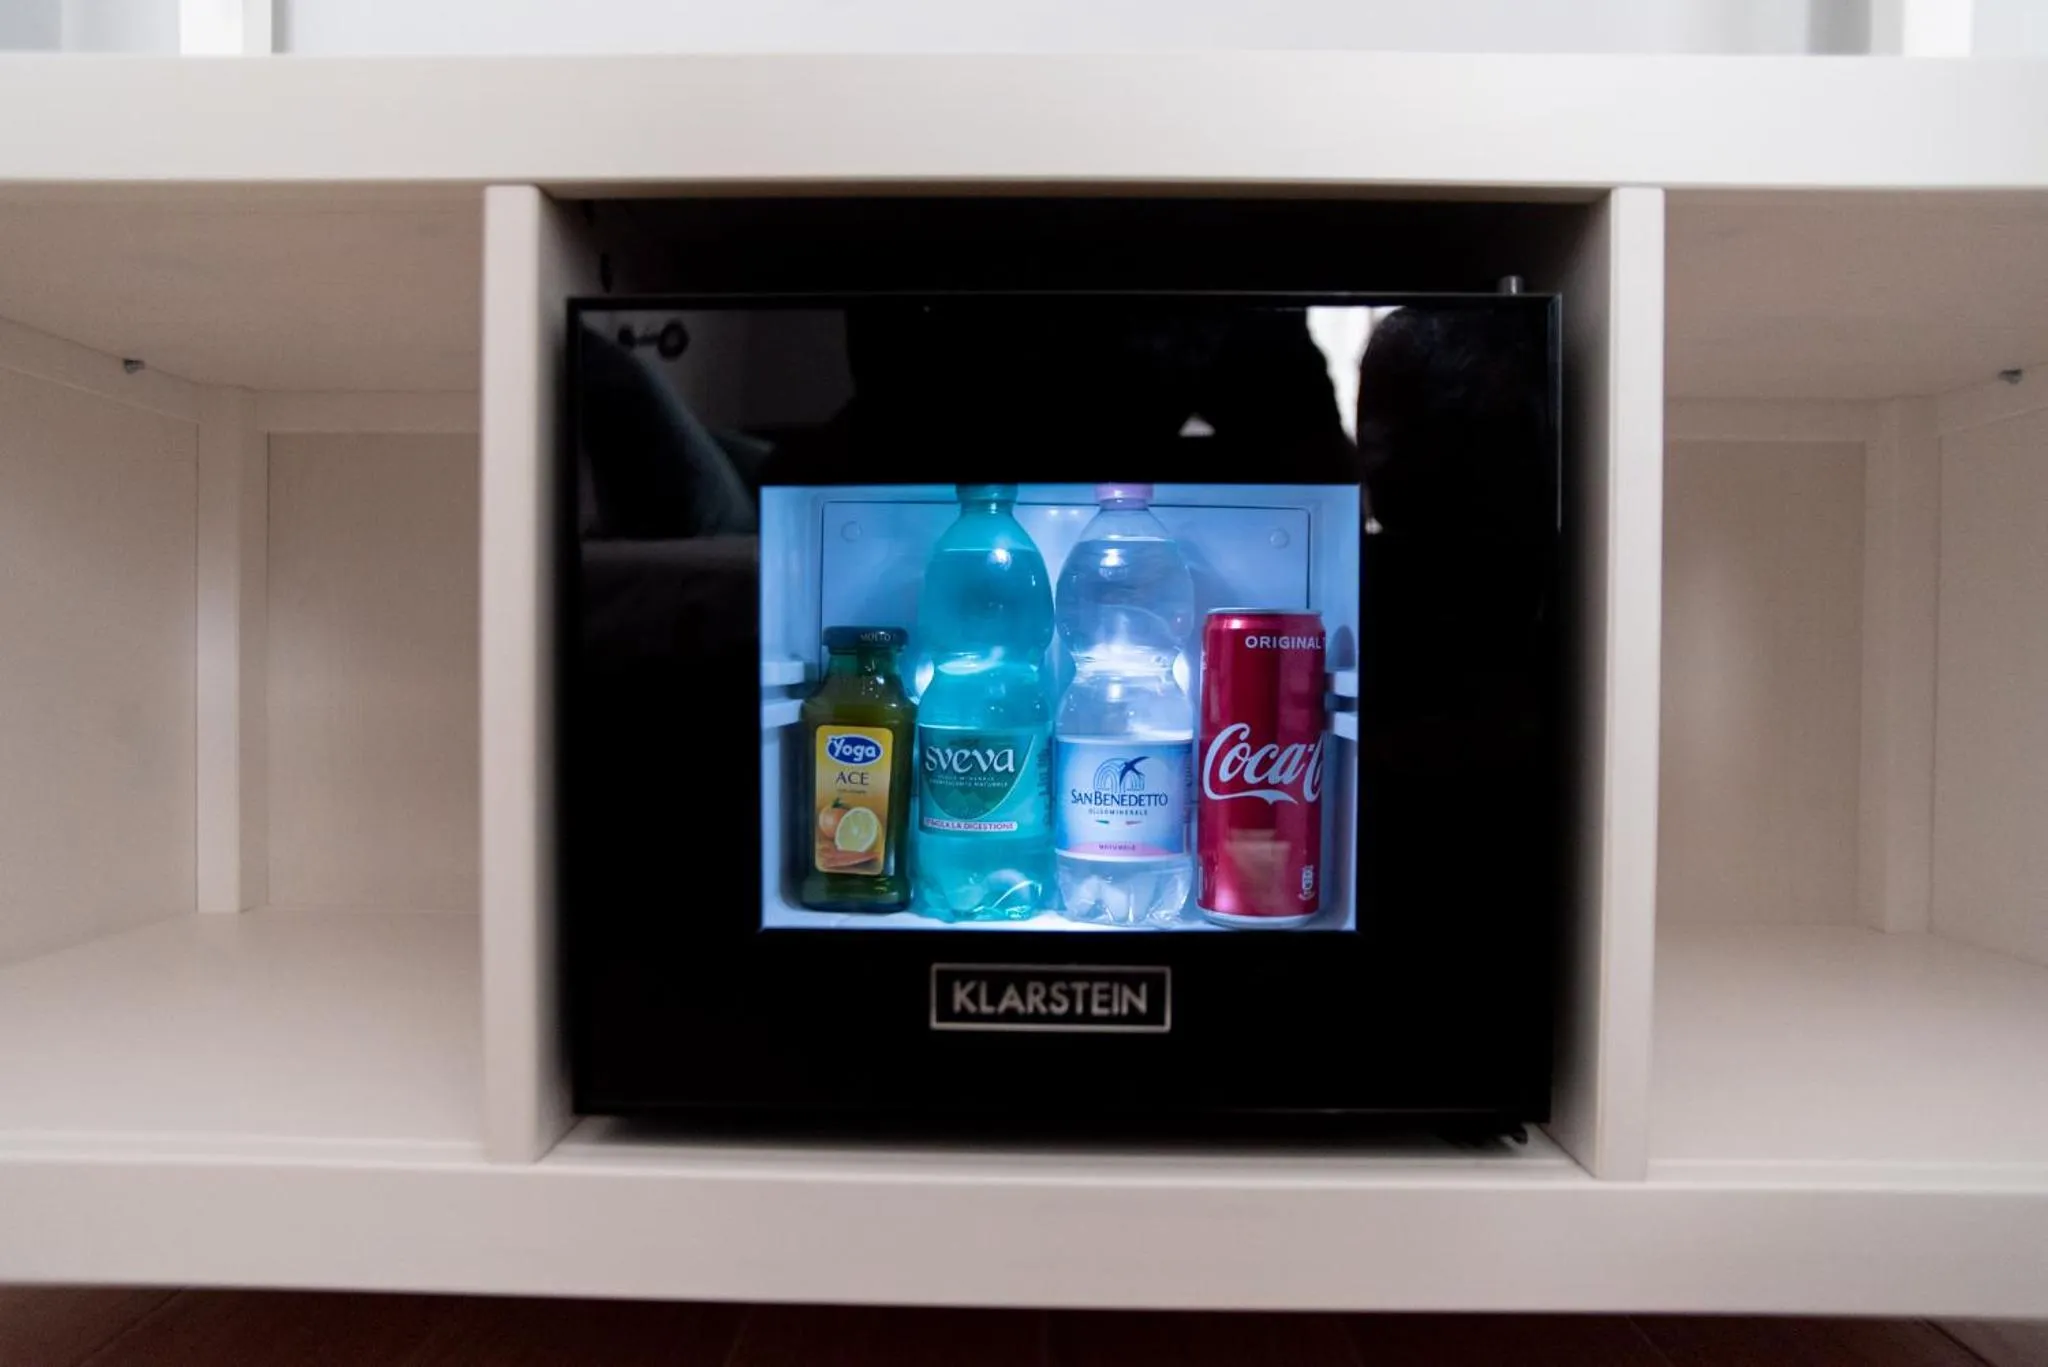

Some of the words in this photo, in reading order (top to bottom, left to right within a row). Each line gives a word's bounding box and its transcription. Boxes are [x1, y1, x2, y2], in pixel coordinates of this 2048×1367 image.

[1244, 635, 1321, 649] ORIGINAL
[831, 737, 877, 762] Yoga
[836, 771, 869, 786] ACE
[1071, 788, 1093, 805] SAN
[1094, 791, 1169, 807] BENEDETTO
[952, 979, 1147, 1016] KLARSTEIN
